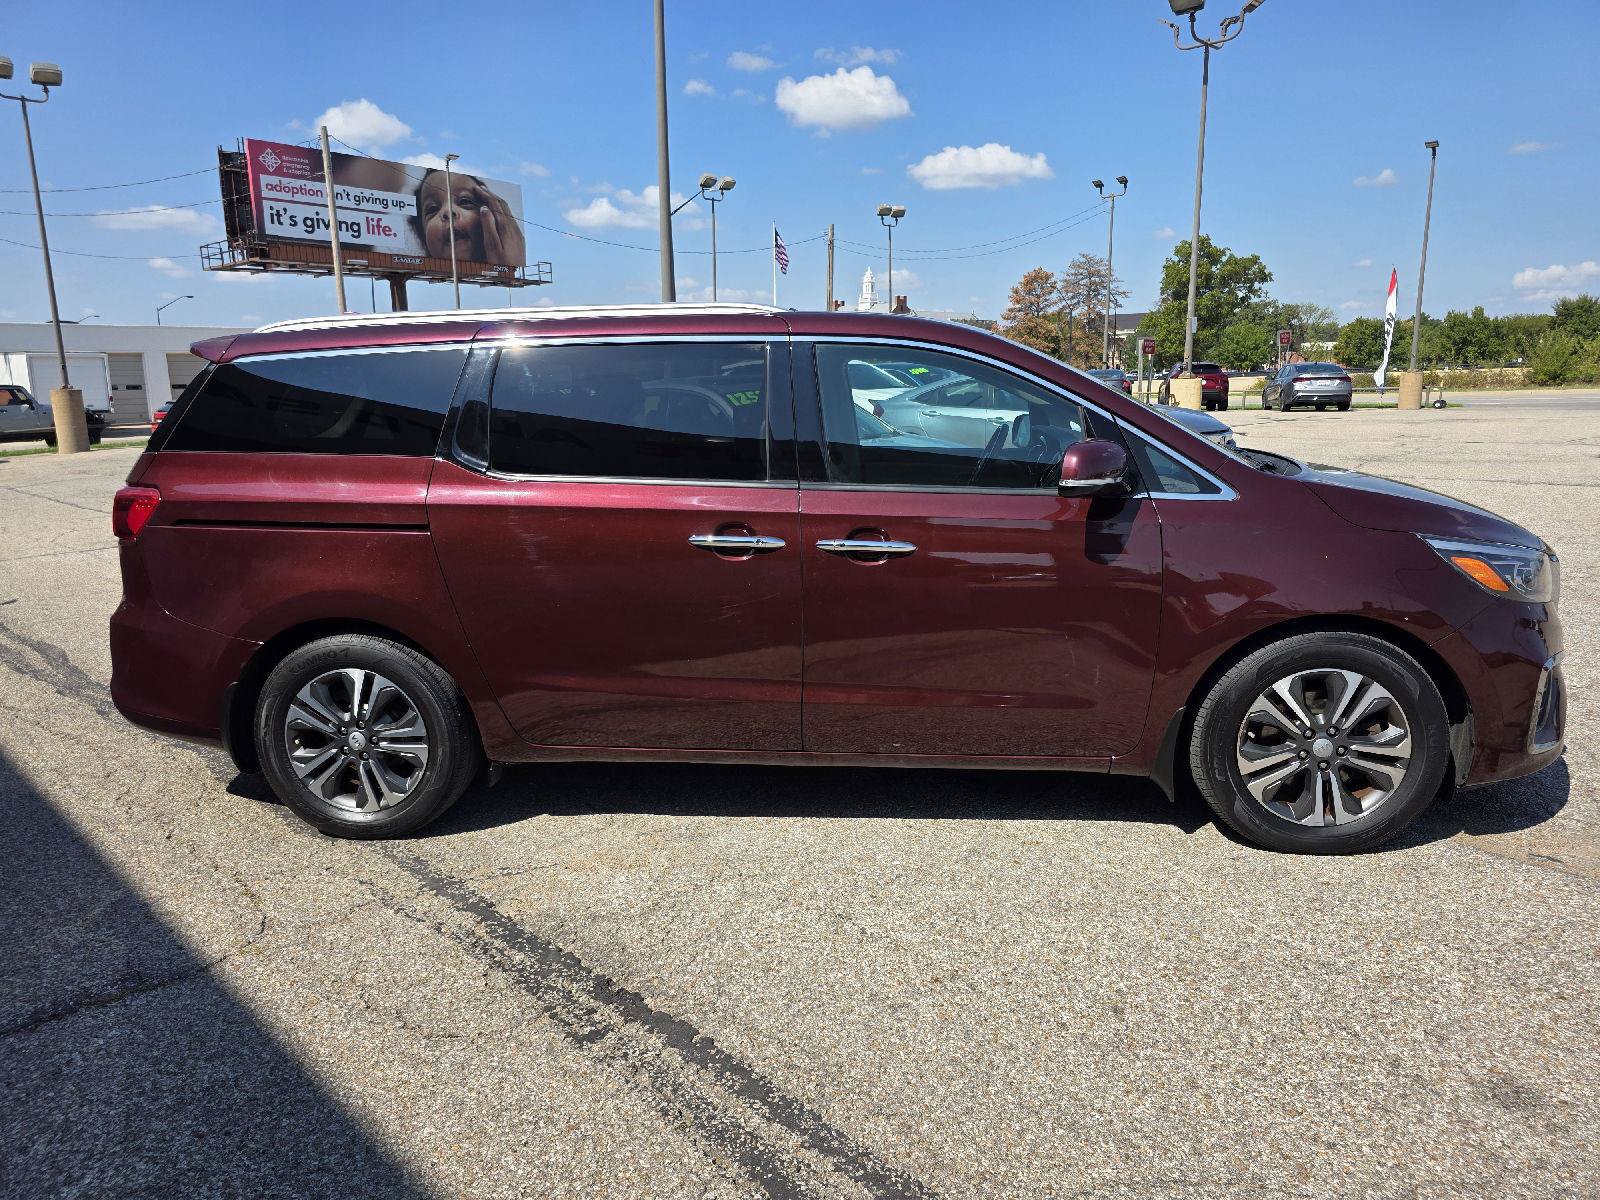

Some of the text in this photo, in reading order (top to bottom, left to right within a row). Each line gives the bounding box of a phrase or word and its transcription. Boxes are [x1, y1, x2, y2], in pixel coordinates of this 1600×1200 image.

[265, 180, 323, 198] adoption
[334, 189, 351, 201] n't
[353, 192, 389, 209] giving
[268, 205, 397, 239] it's givng life.
